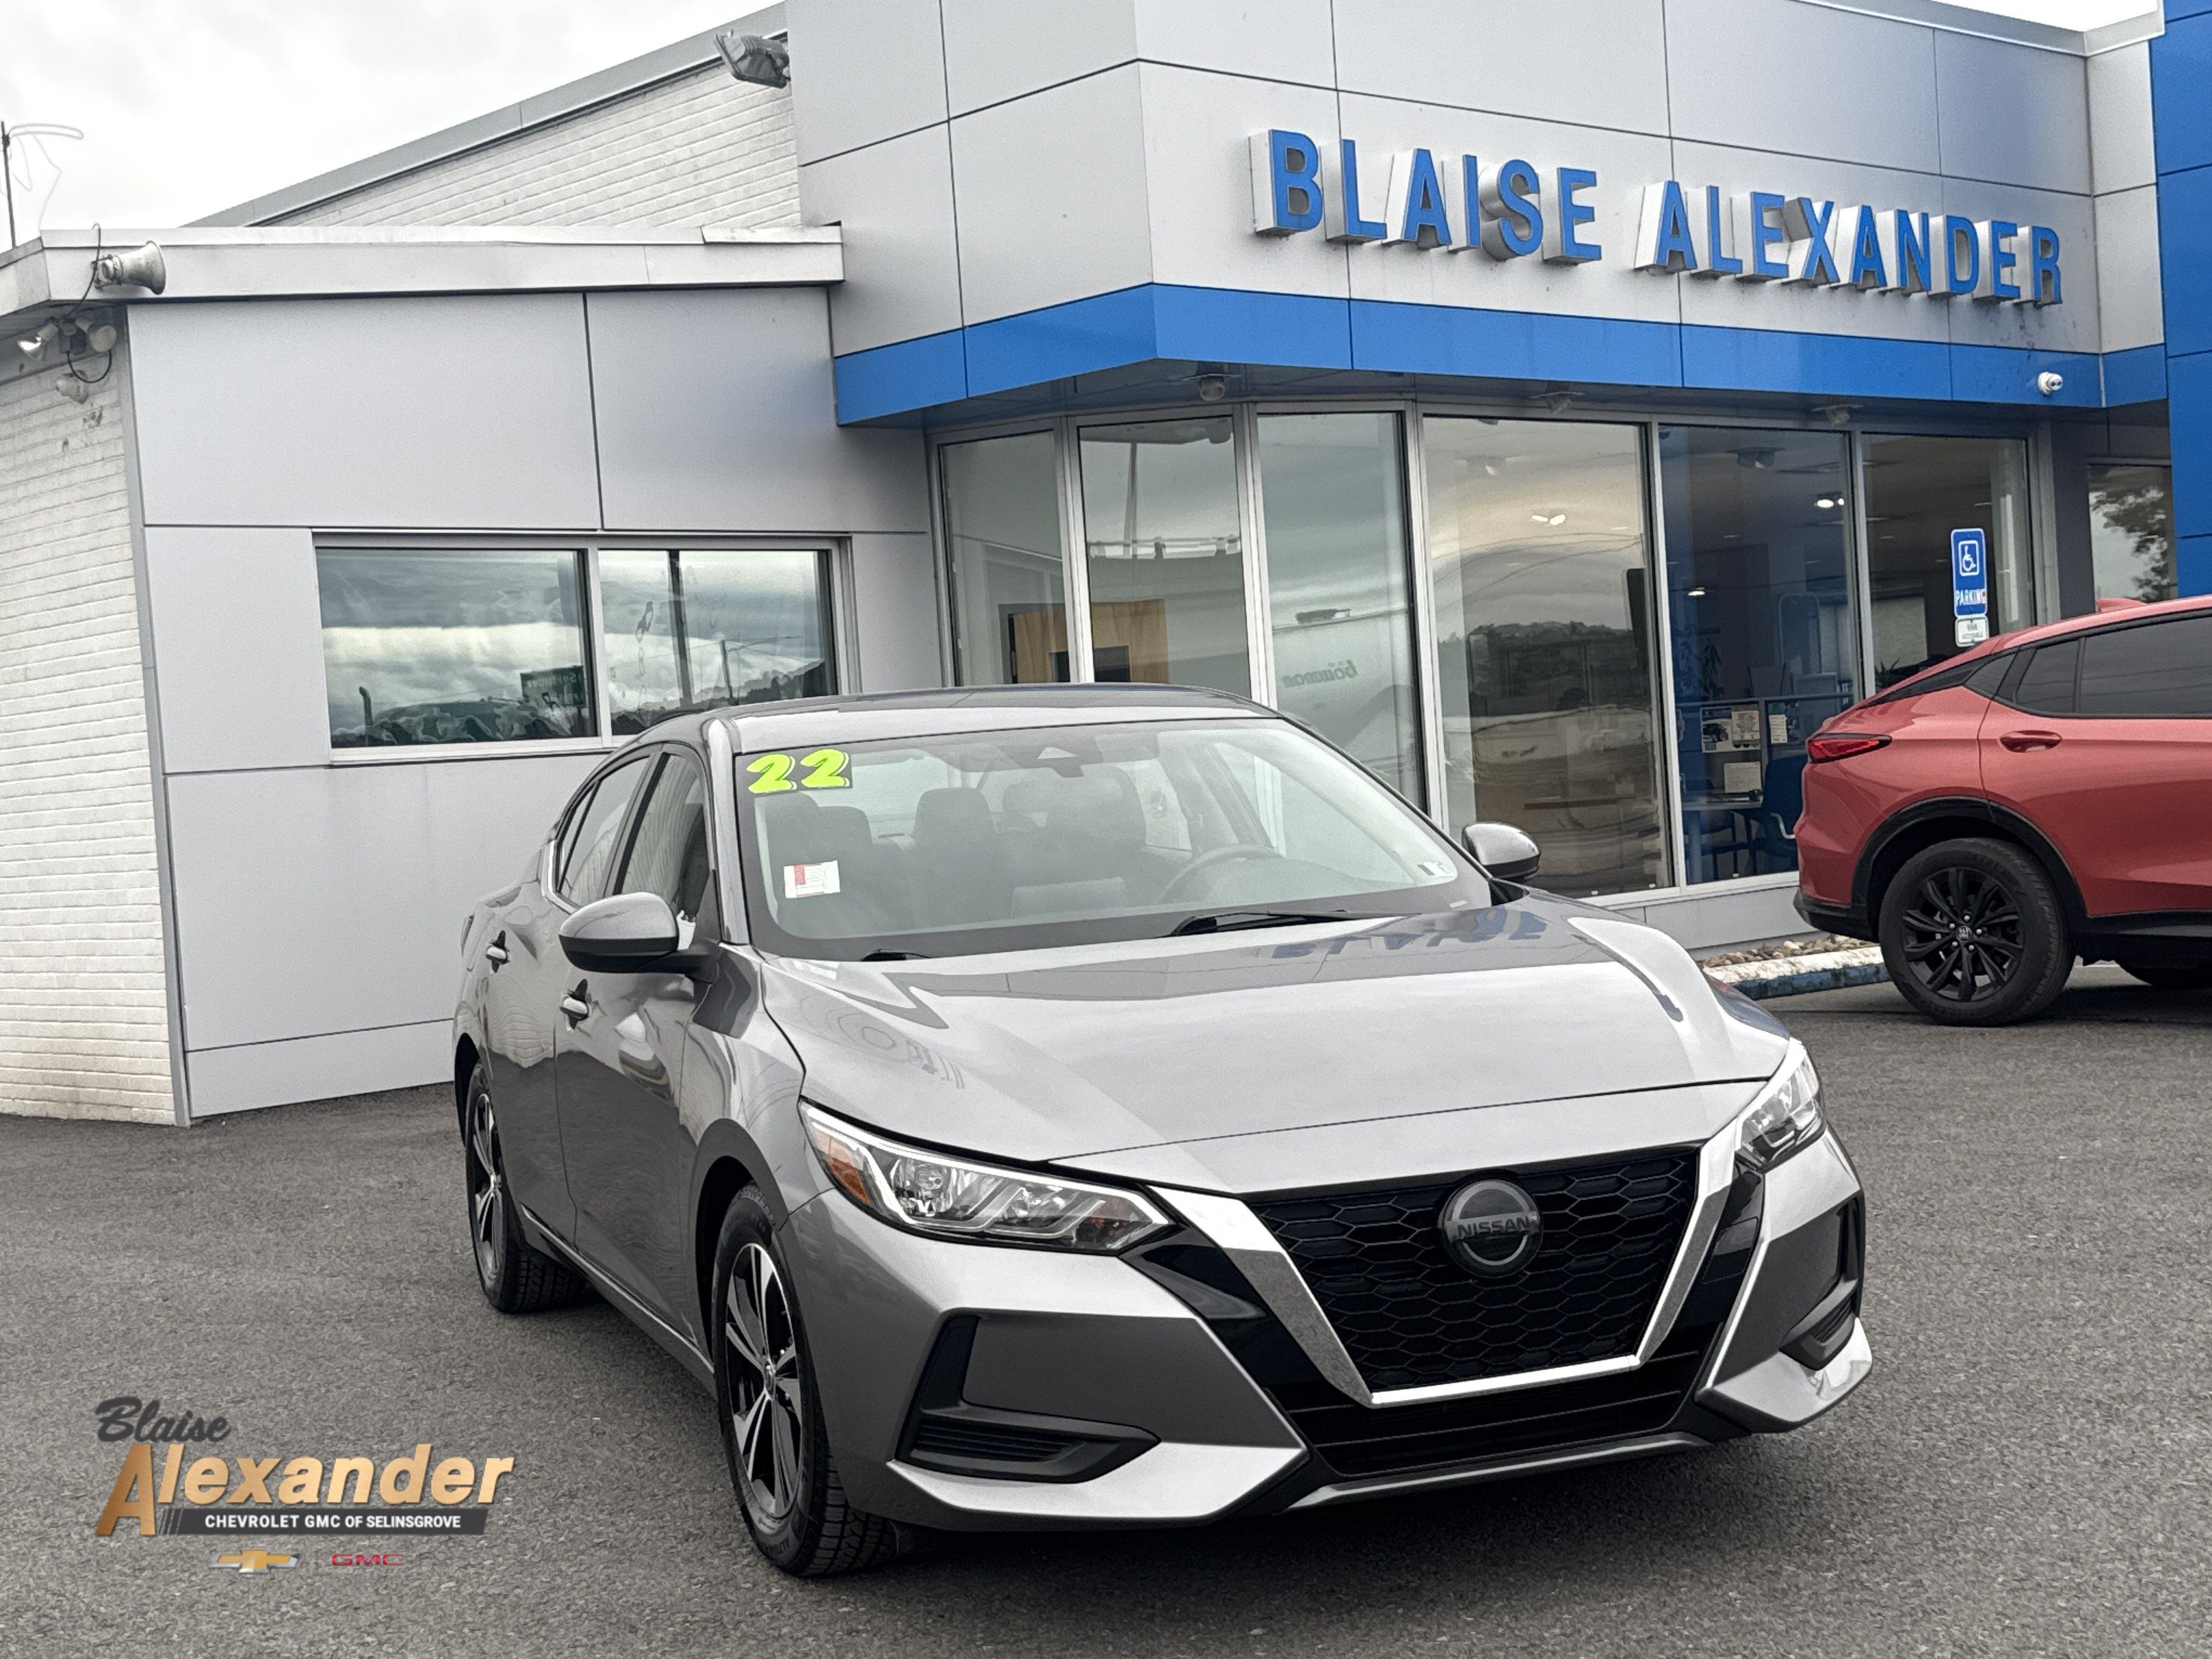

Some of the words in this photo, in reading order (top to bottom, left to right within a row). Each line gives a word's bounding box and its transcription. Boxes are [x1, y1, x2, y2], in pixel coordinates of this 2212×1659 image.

[1267, 128, 1602, 261] BLAISE
[1654, 180, 2063, 305] ALEXANDER
[746, 748, 850, 793] 22
[1457, 1216, 1530, 1239] NISSAN
